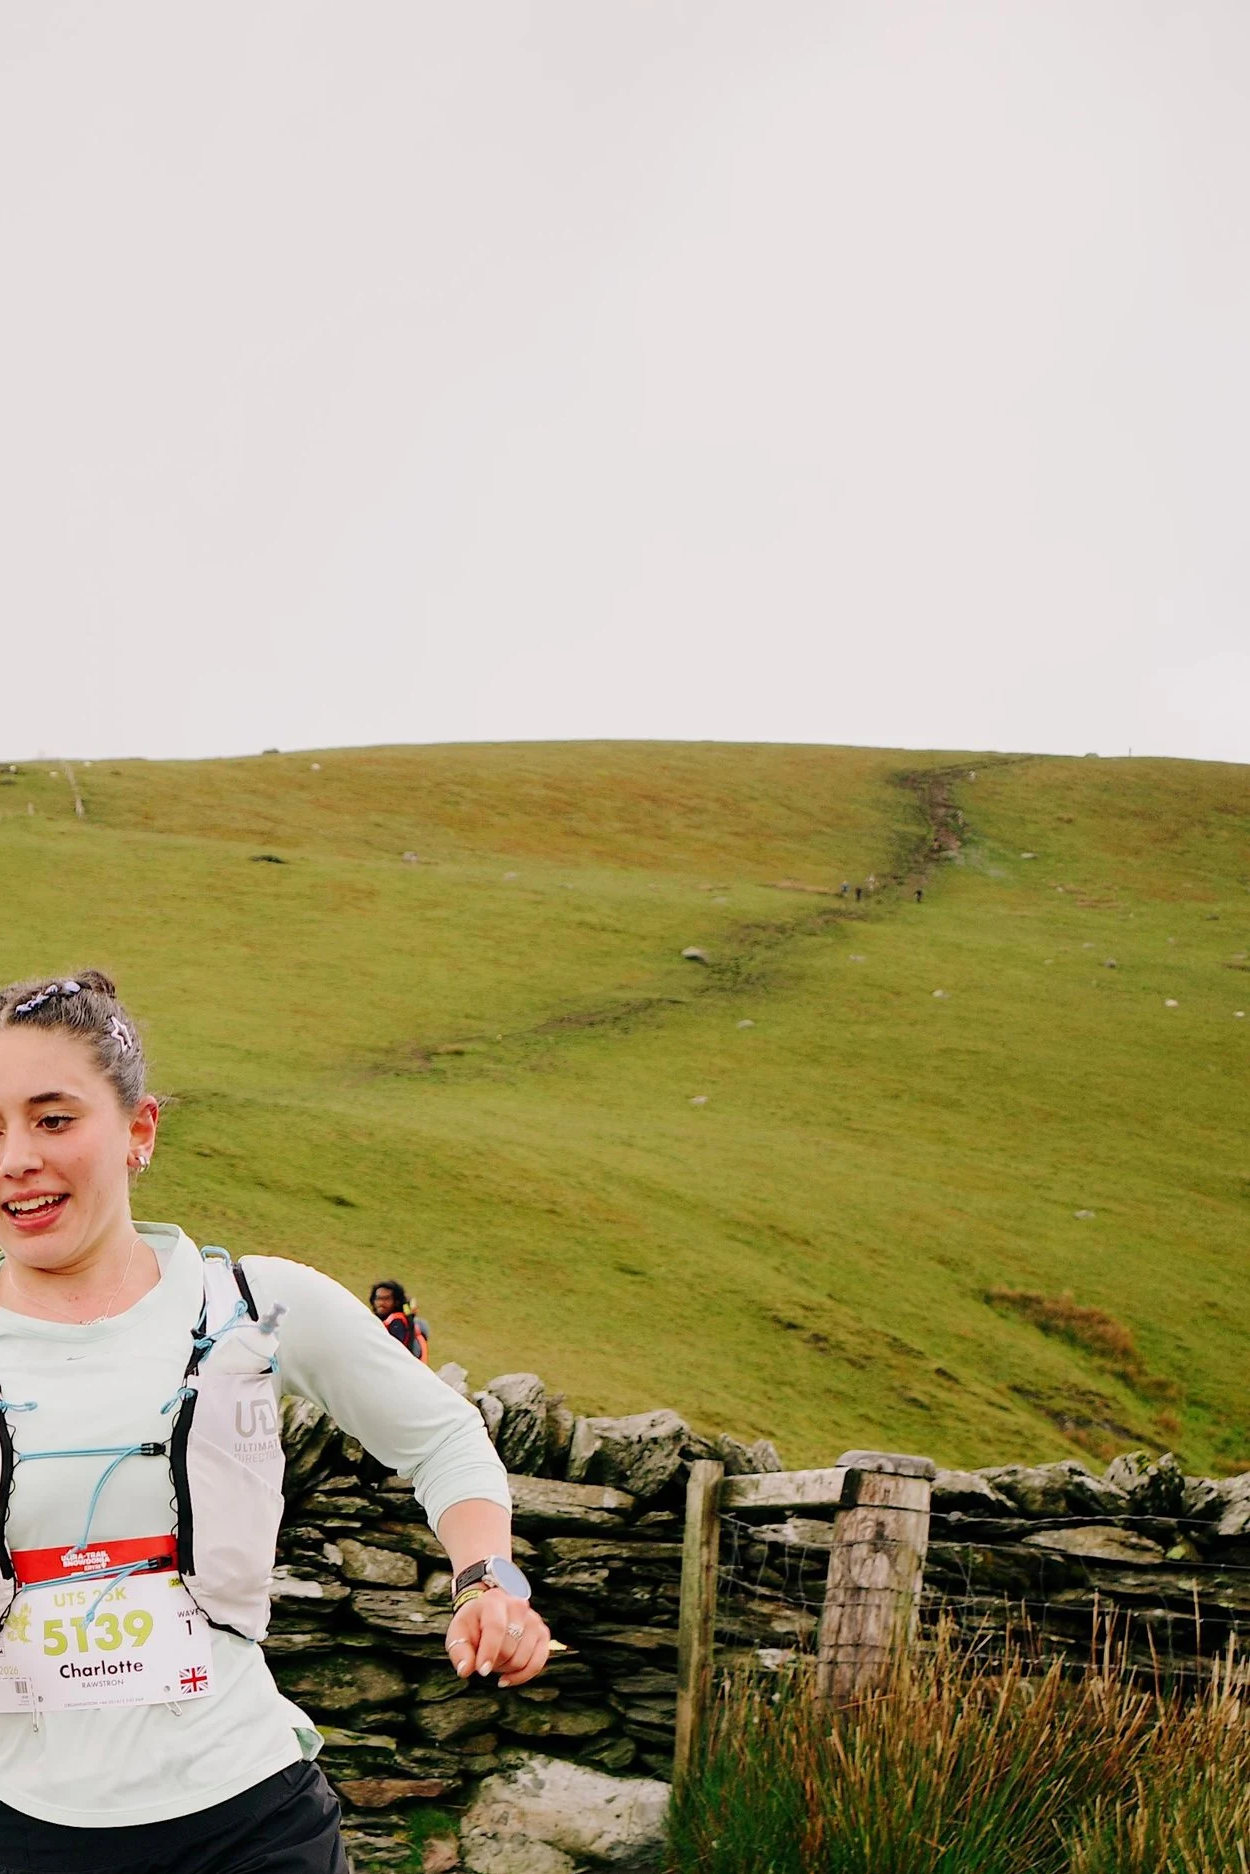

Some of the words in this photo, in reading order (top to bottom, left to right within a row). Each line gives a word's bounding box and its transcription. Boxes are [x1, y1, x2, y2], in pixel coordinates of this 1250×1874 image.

[54, 1591, 86, 1608] UTS
[177, 1609, 200, 1618] WAVE
[44, 1610, 154, 1656] 5139
[186, 1620, 192, 1635] 1
[60, 1660, 143, 1678] Charlotte
[82, 1679, 124, 1688] RAWSTRON
